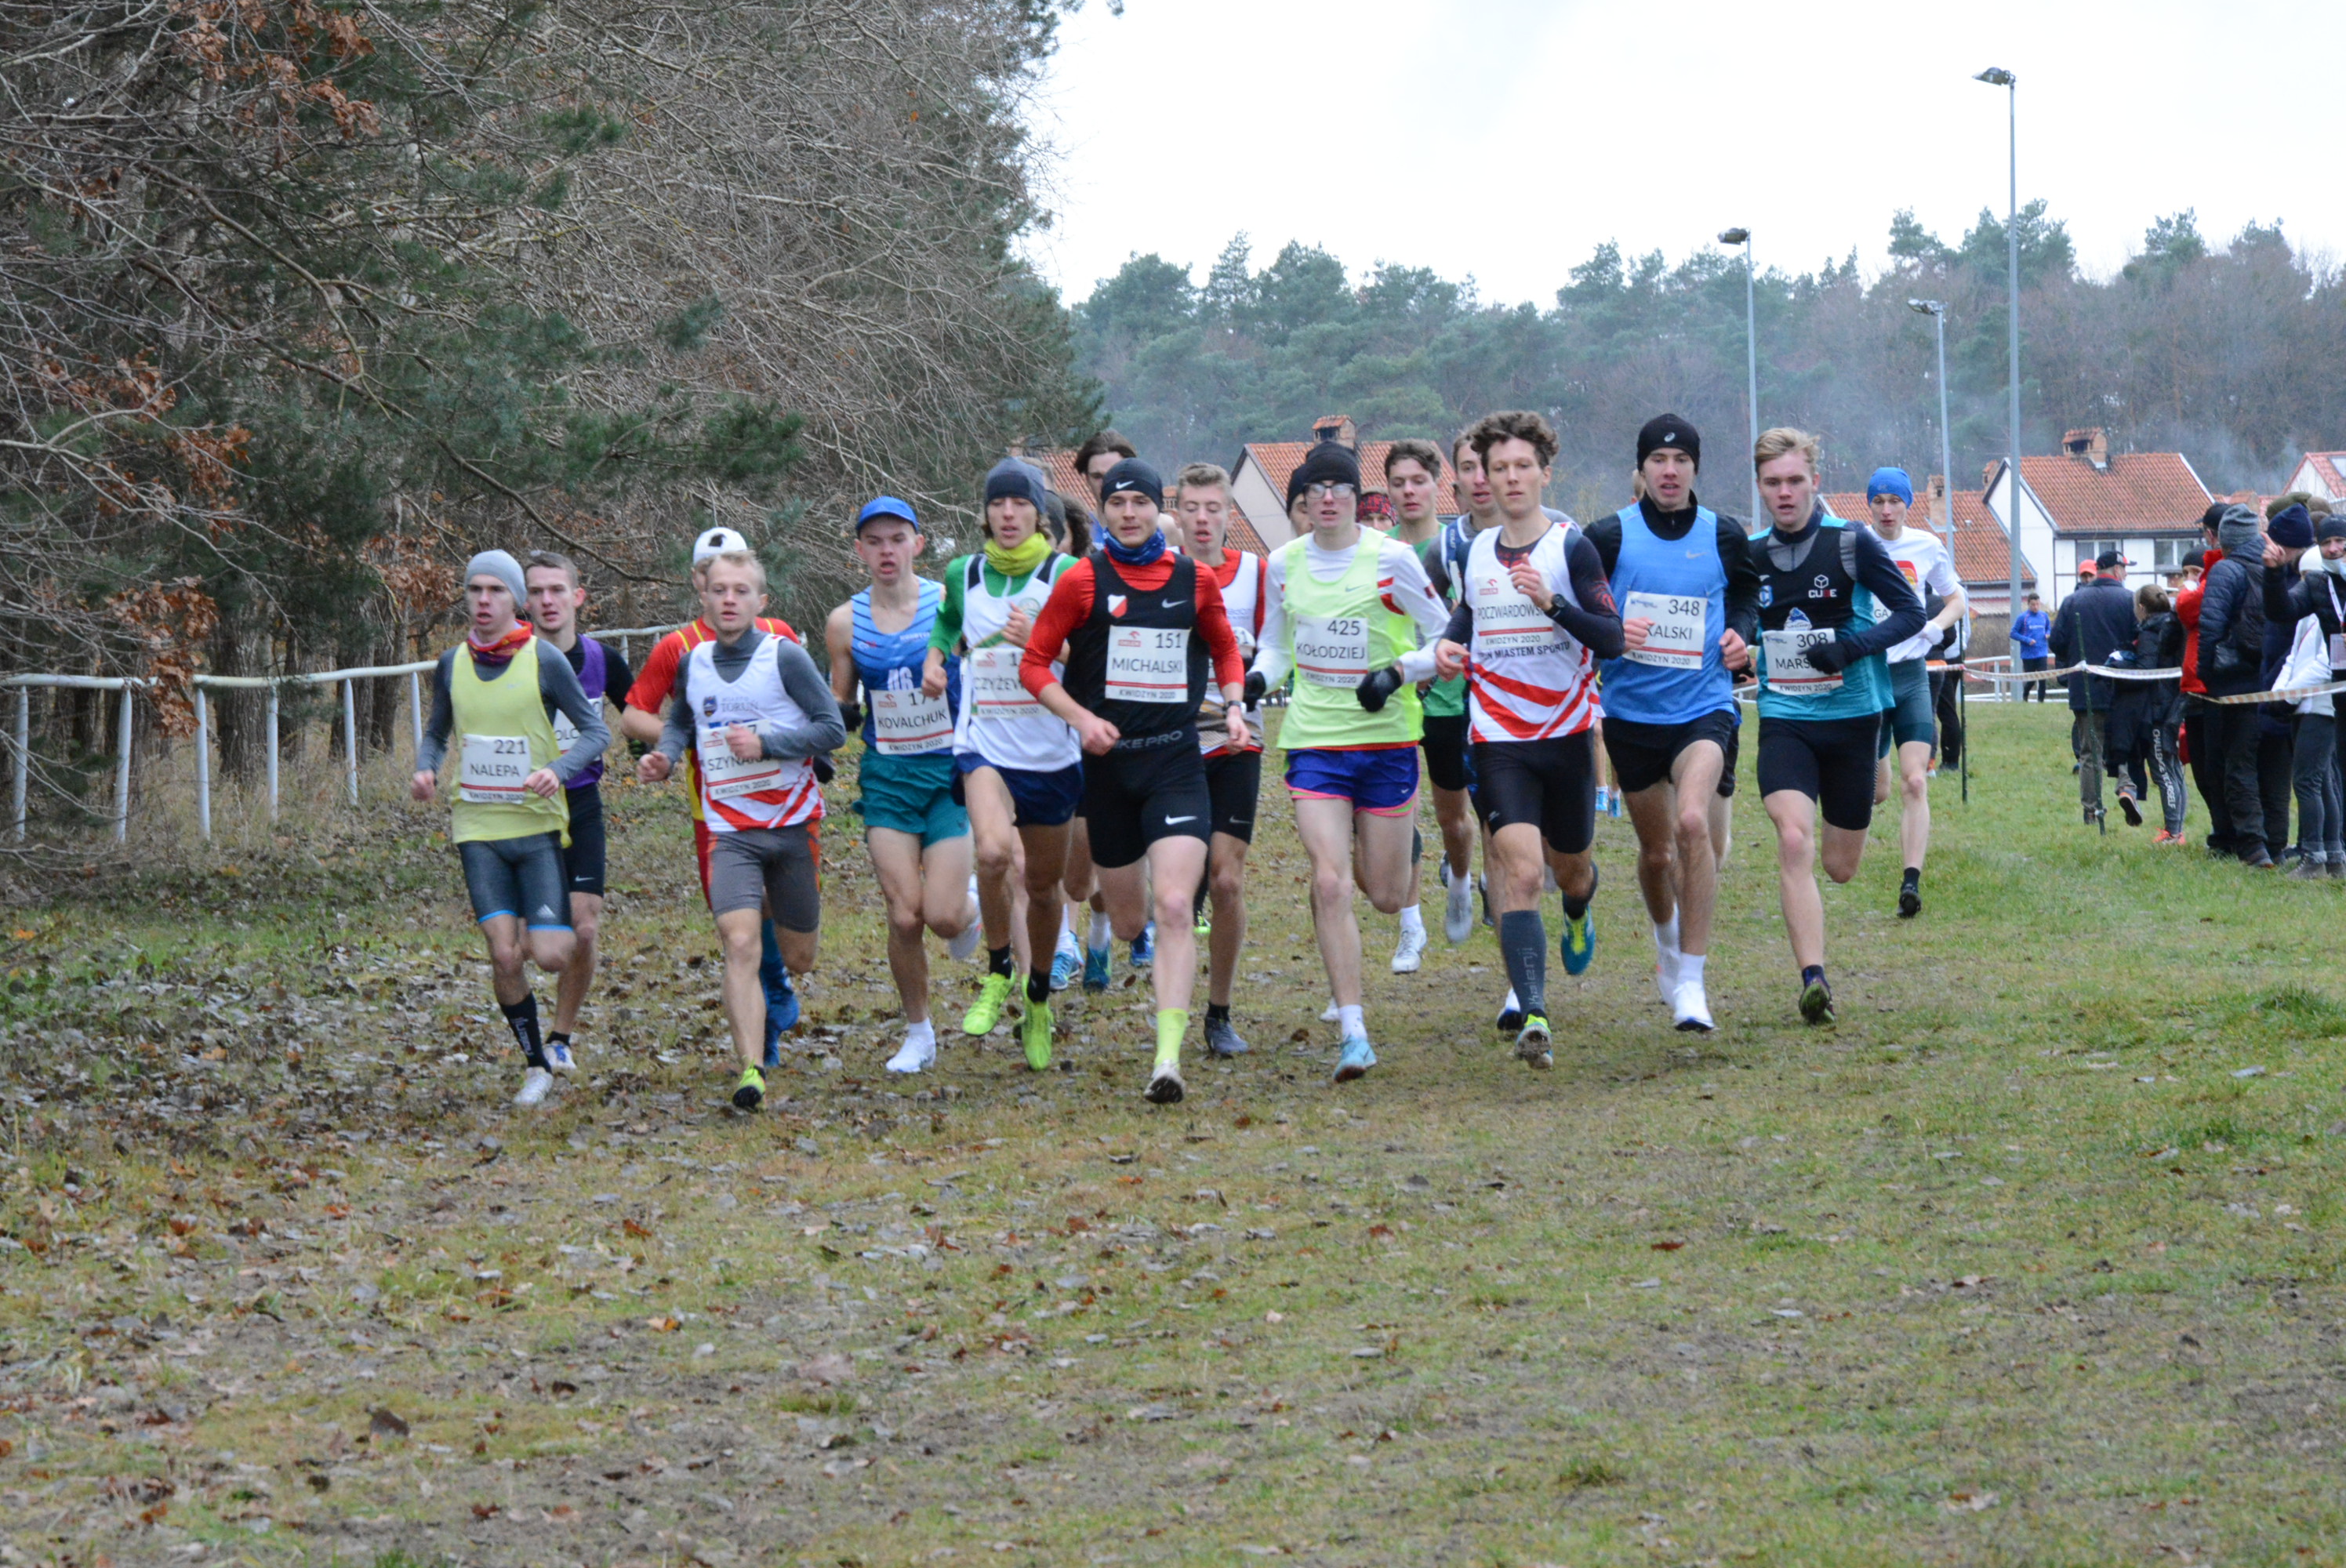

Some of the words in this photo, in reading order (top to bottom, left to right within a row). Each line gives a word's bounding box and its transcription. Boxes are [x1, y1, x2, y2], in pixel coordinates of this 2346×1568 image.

[1808, 590, 1837, 598] CUBE
[1668, 599, 1700, 616] 348
[1327, 620, 1360, 636] 425
[1647, 625, 1693, 640] KALSKI
[1155, 633, 1181, 648] 151
[1796, 632, 1828, 648] 308
[1296, 643, 1365, 659] KOŁODZIEJ
[1494, 646, 1534, 659] MIASTEM
[1538, 641, 1571, 655] SPORTU
[1112, 658, 1183, 673] MICHALSKI
[1632, 652, 1669, 663] KWIDZYN
[1671, 655, 1690, 665] 2020
[1775, 657, 1810, 670] MARS
[1119, 689, 1157, 698] KWIDZYN
[877, 710, 947, 729] KOVALCHUK
[493, 739, 526, 754] 221
[889, 742, 923, 752] KWIDZYN
[926, 739, 944, 749] 2020
[470, 763, 521, 777] NALEPA
[715, 784, 750, 796] KWIDZYN
[753, 779, 772, 789] 2020
